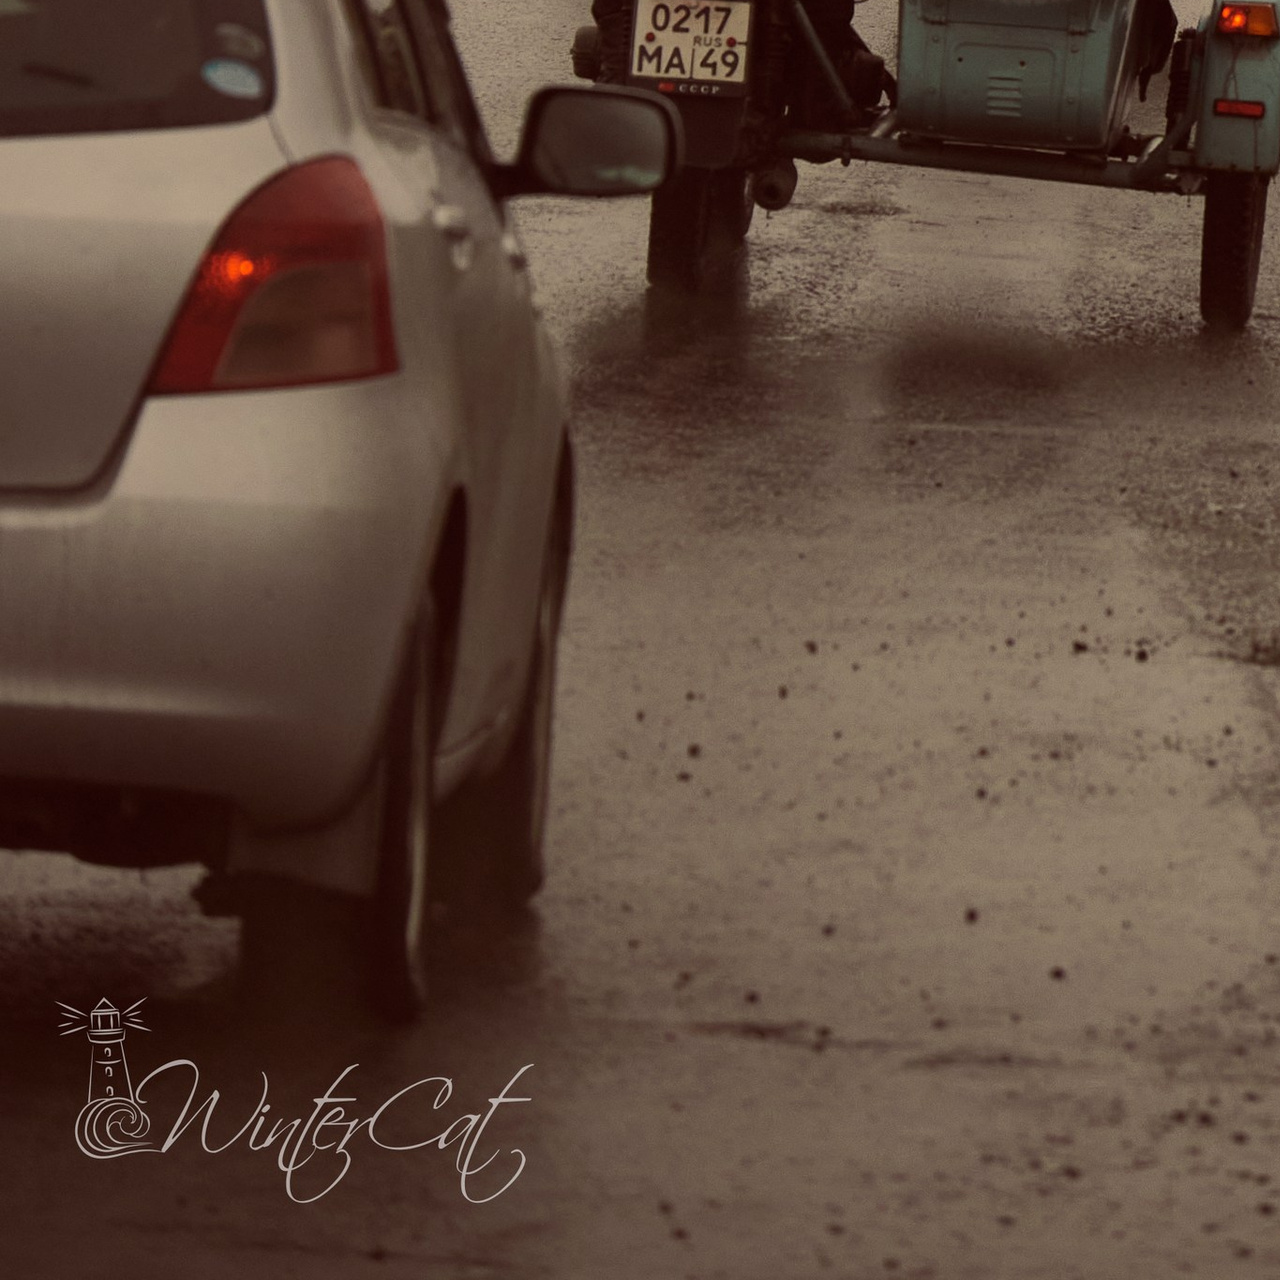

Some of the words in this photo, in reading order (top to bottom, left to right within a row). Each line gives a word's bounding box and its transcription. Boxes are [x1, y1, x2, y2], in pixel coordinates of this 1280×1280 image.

[651, 3, 731, 35] 0217
[693, 36, 722, 48] RUS
[700, 48, 739, 77] 49
